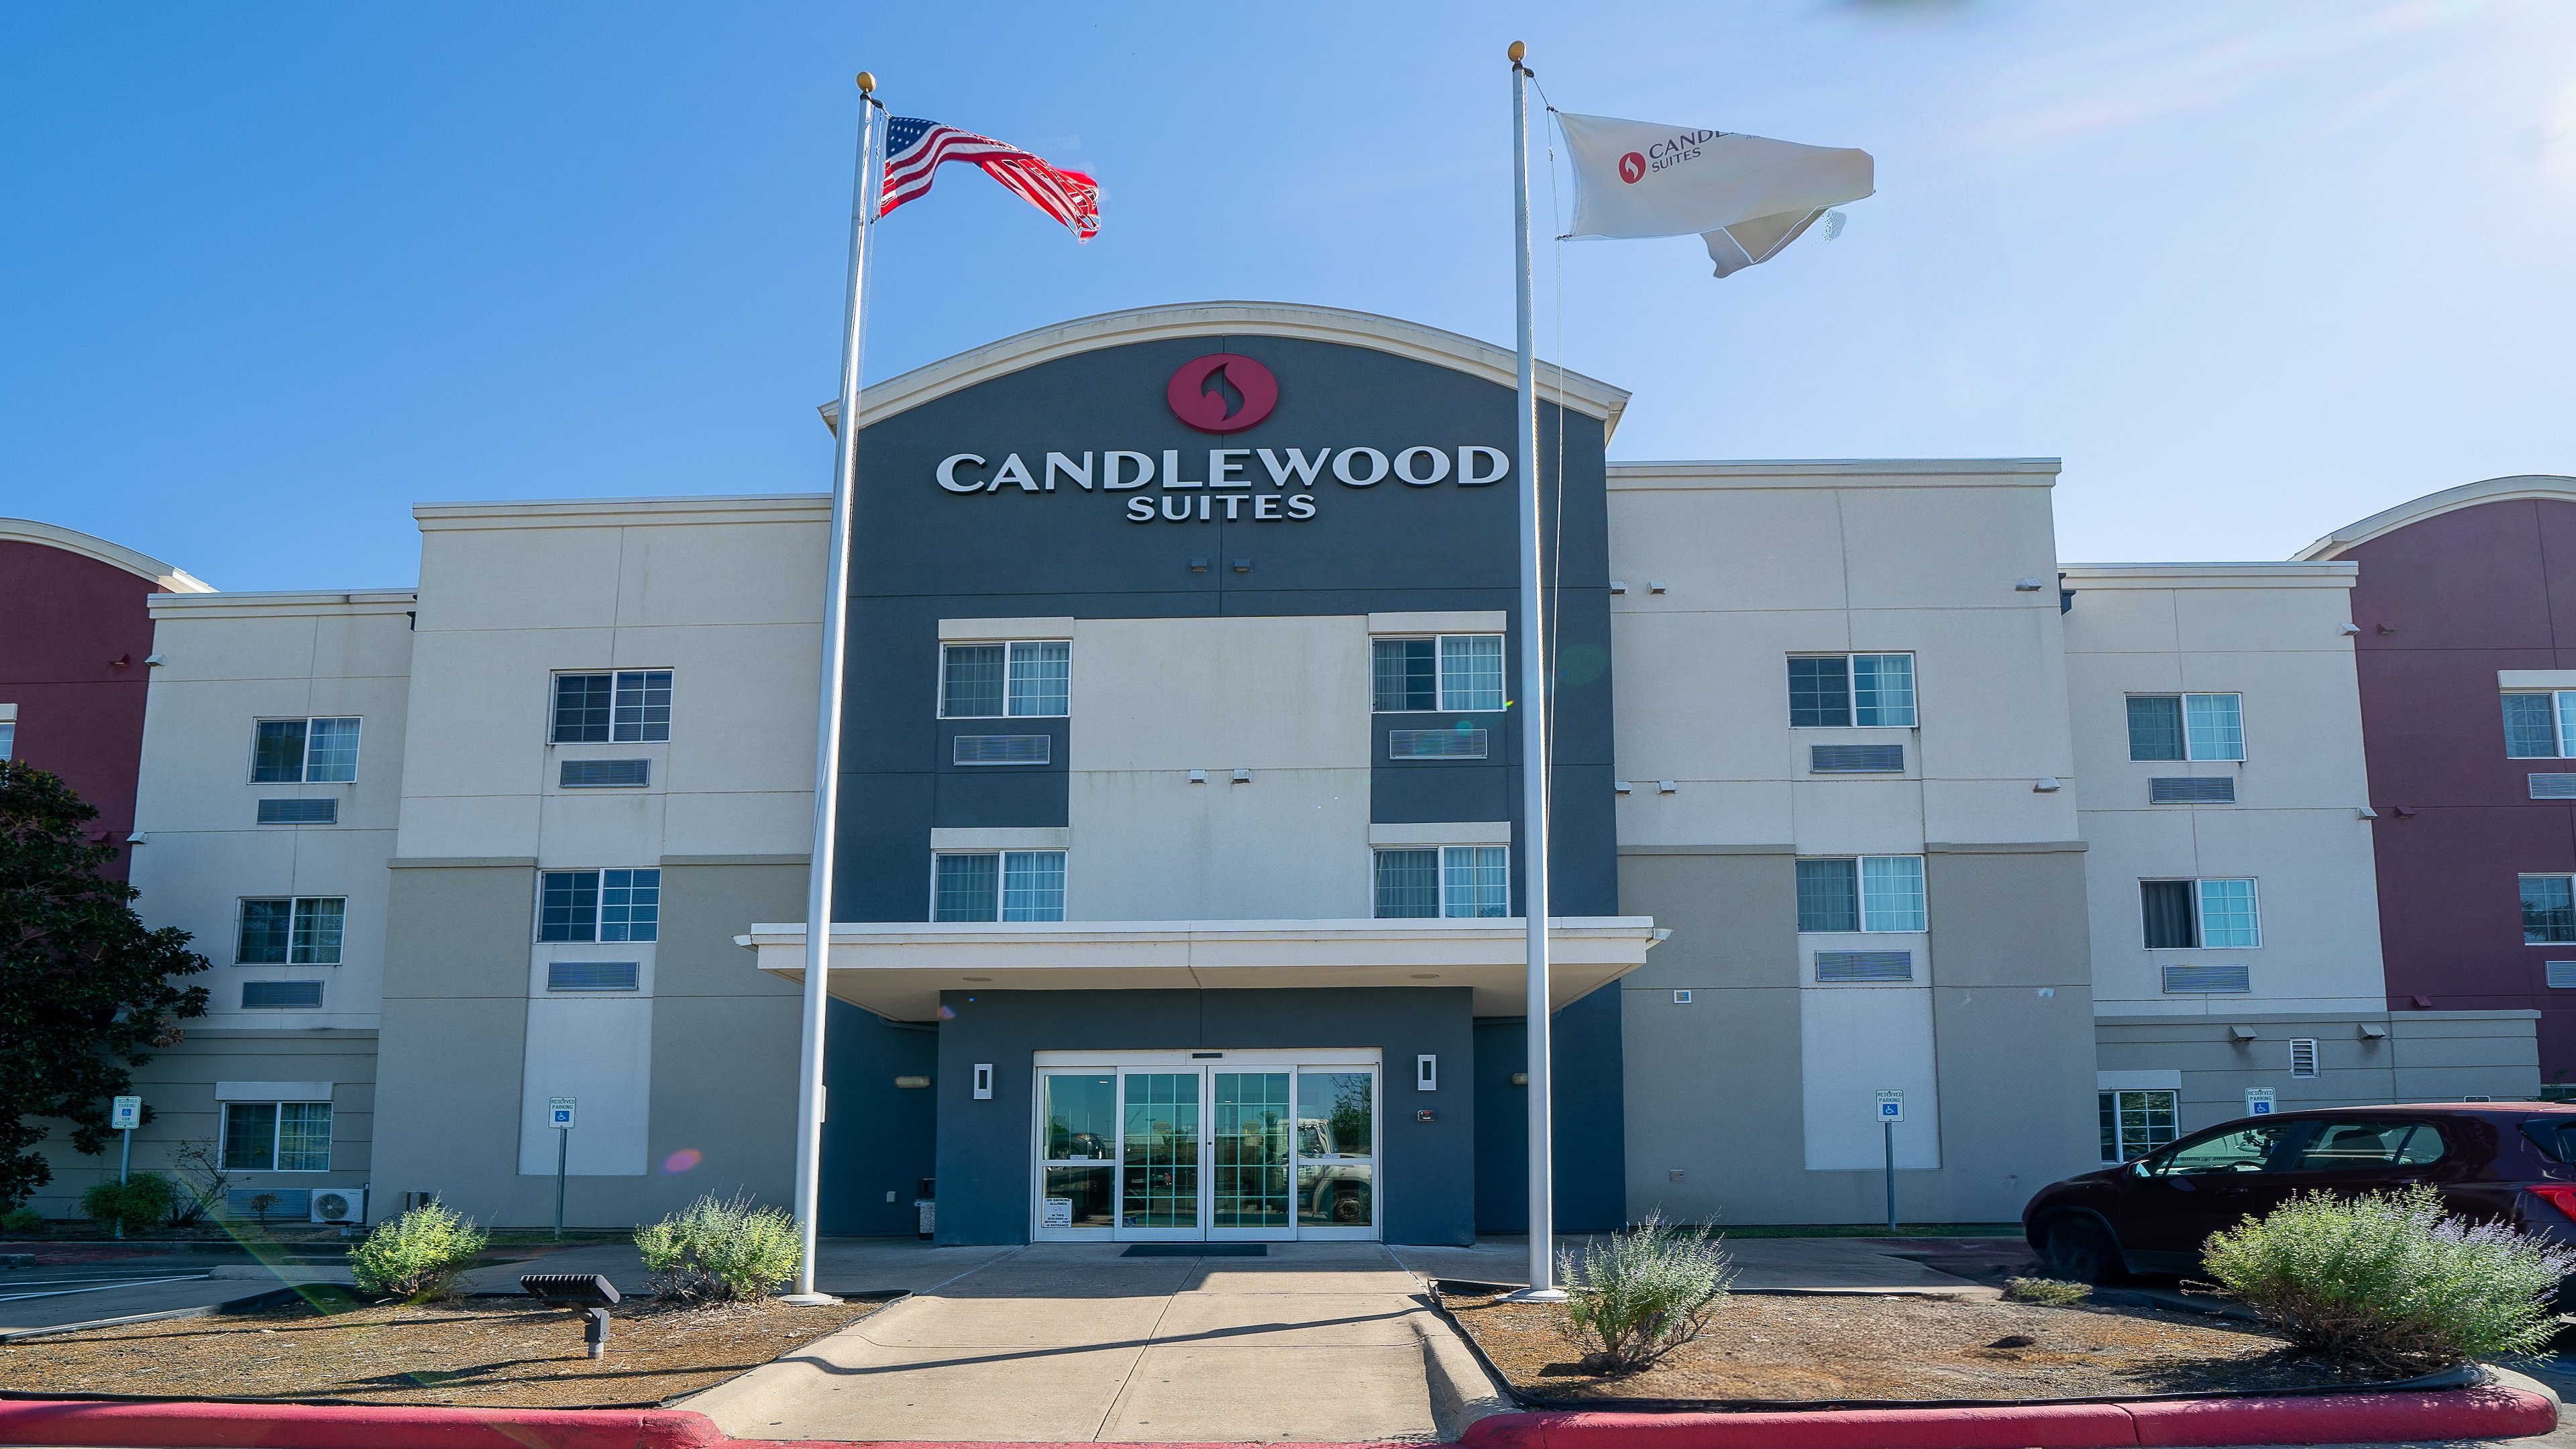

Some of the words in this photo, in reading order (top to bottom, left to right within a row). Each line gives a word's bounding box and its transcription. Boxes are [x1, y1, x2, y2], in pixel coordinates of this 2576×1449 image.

[1648, 129, 1735, 159] CANDL
[1652, 147, 1701, 172] SUITES
[936, 445, 1510, 494] CANDLEWOOD
[1126, 494, 1316, 522] SUITES
